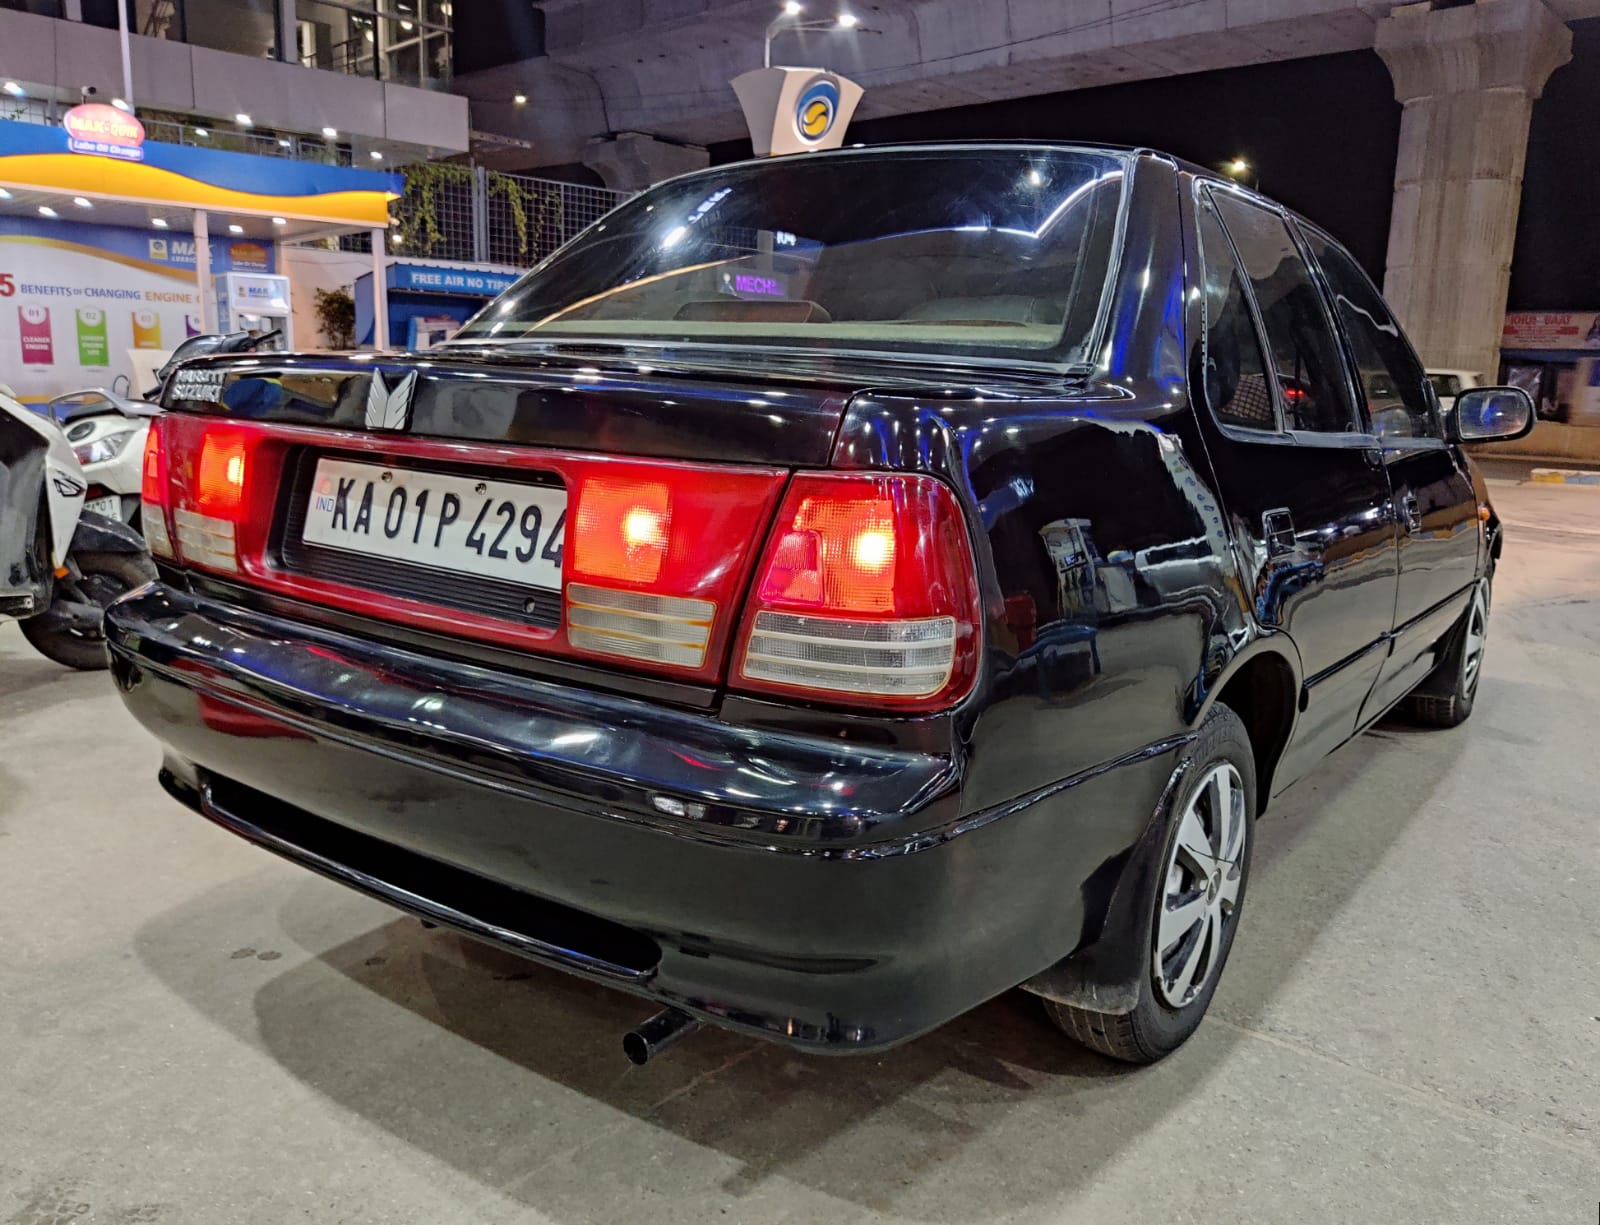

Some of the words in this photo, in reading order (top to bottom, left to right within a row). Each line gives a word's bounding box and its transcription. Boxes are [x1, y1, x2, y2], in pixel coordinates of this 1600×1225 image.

[0, 273, 16, 297] 5
[20, 283, 72, 297] BENEFITS
[84, 287, 141, 300] CHANGING
[144, 291, 193, 303] ENGINE
[411, 272, 441, 285] FREE
[444, 275, 465, 286] AIR
[467, 278, 484, 289] NO
[172, 384, 222, 403] SUZUKI
[316, 495, 335, 512] IND
[465, 498, 567, 568] 4294
